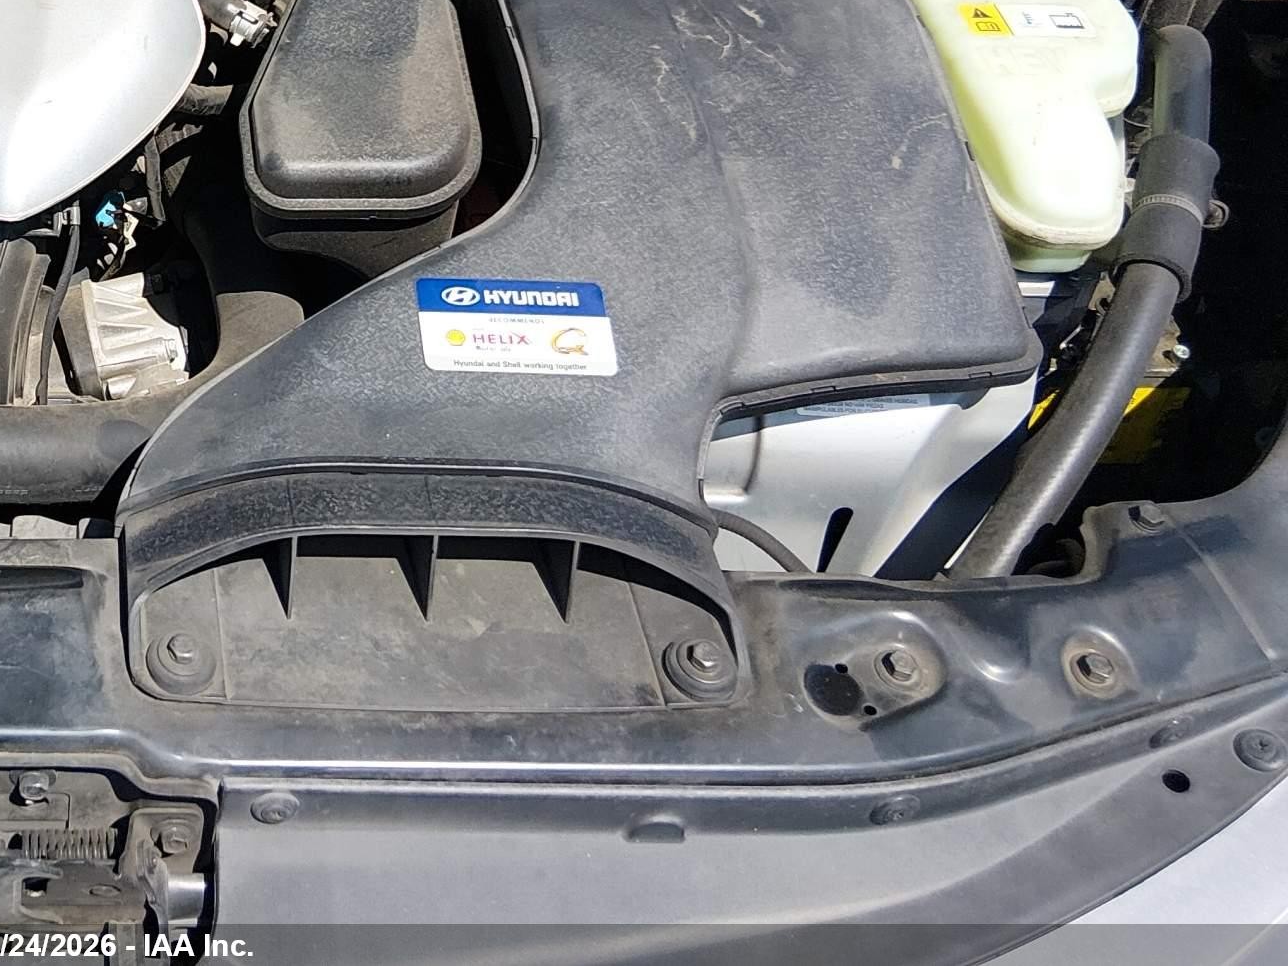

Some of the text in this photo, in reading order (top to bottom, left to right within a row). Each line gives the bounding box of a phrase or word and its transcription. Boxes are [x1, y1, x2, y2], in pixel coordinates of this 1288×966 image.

[483, 289, 580, 307] HYUNDAI
[472, 332, 530, 345] HELIX
[453, 360, 484, 369] Hyundai
[524, 362, 554, 371] working
[556, 363, 587, 371] together
